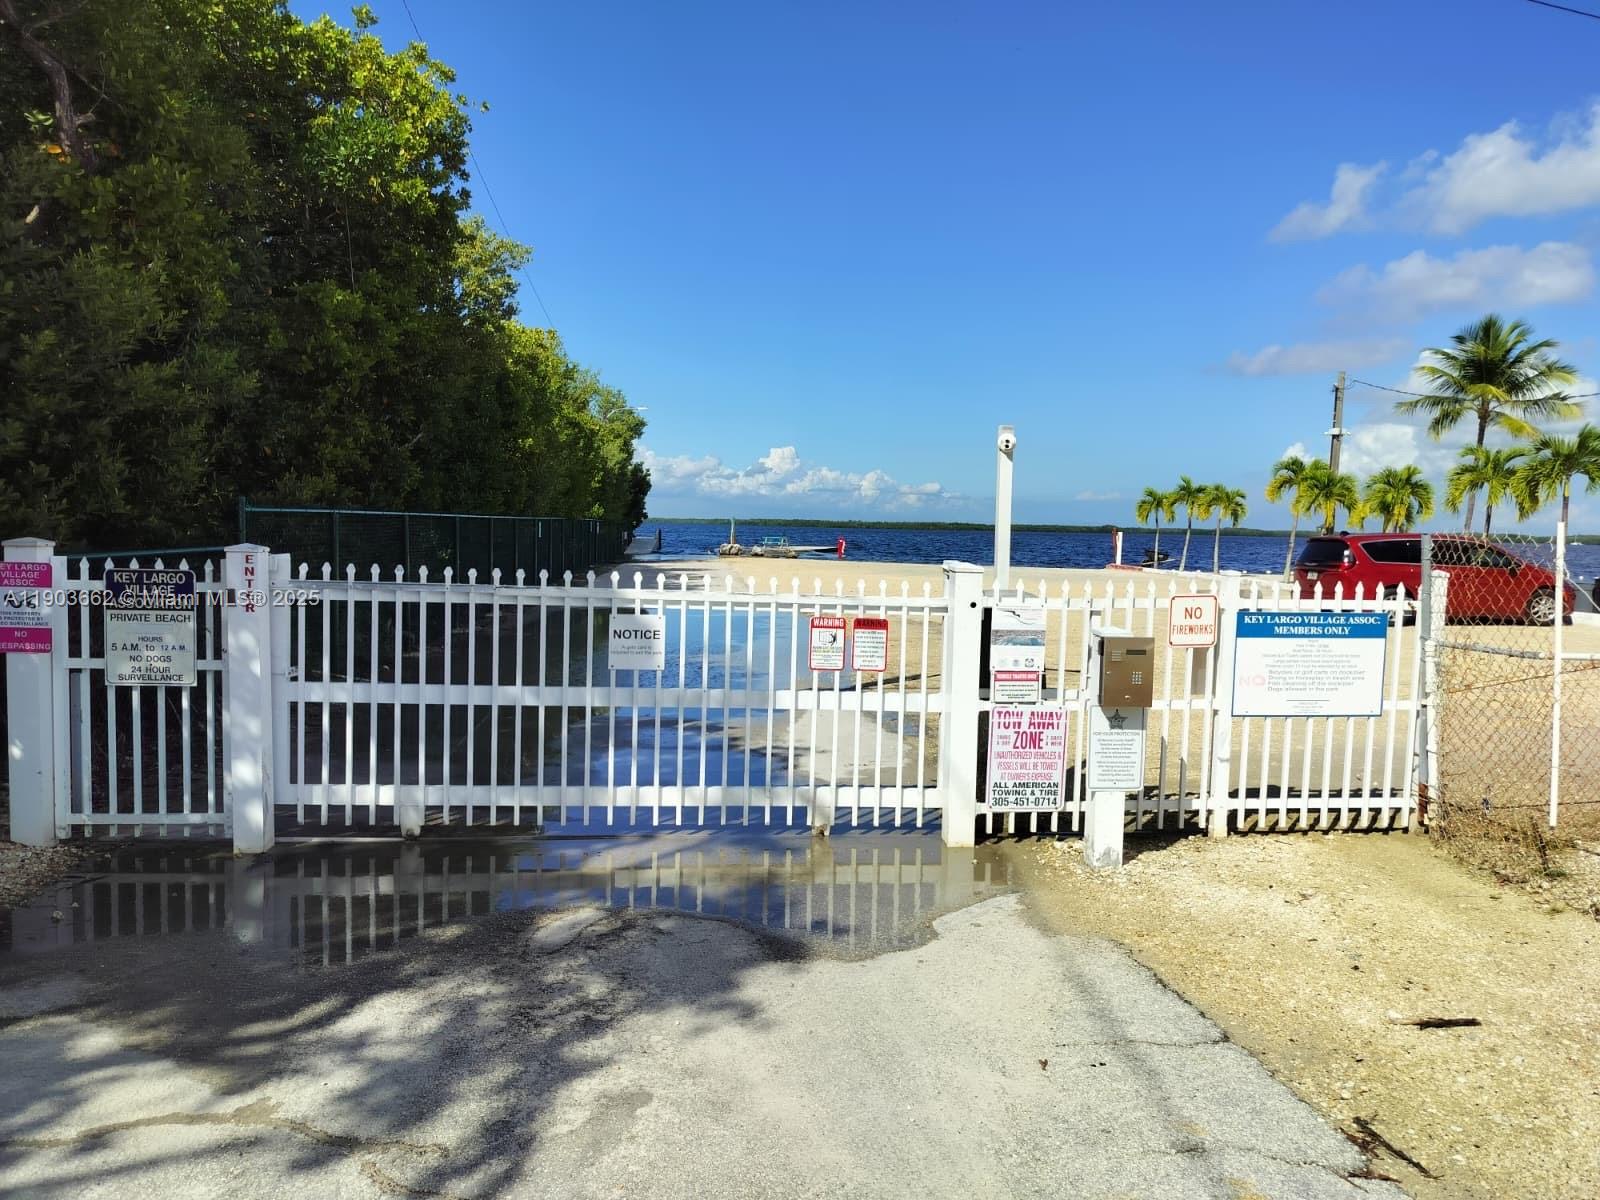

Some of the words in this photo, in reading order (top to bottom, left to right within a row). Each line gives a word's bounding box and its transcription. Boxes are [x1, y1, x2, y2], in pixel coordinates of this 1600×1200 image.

[0, 563, 13, 571] EY
[15, 563, 48, 571] LARGO
[113, 572, 138, 583] KEY
[143, 573, 186, 584] LARGO
[125, 584, 176, 596] VILLAGE
[1184, 606, 1203, 620] NO
[110, 613, 151, 623] PRIVATE
[155, 614, 191, 624] BEACH
[813, 618, 844, 626] WARNING
[1244, 615, 1265, 624] KEY
[1266, 615, 1301, 624] LARGO
[1303, 615, 1346, 624] VILLAGE
[1347, 616, 1381, 625] ASSOC.
[14, 630, 28, 638] NO
[1172, 624, 1214, 635] FIREWORKS
[1273, 626, 1323, 635] MEMBERS
[1324, 626, 1352, 635] ONLY
[613, 629, 662, 640] NOTICE
[111, 643, 118, 652] 5
[145, 644, 156, 652] to
[146, 666, 171, 674] HOUR
[118, 674, 184, 682] SURVEILLANCE
[996, 710, 1024, 730] TOW
[1027, 710, 1063, 730] AWAY
[1012, 731, 1044, 750] ZONE
[993, 751, 1033, 760] UNAUTHORIZED
[1033, 751, 1057, 760] VEHICLES
[997, 762, 1019, 770] VESSELS
[1020, 762, 1031, 770] WILL
[1032, 762, 1041, 770] BE
[1041, 762, 1058, 771] TOWED
[1031, 773, 1054, 781] EXPENSE
[991, 797, 1057, 807] 305-451-0714
